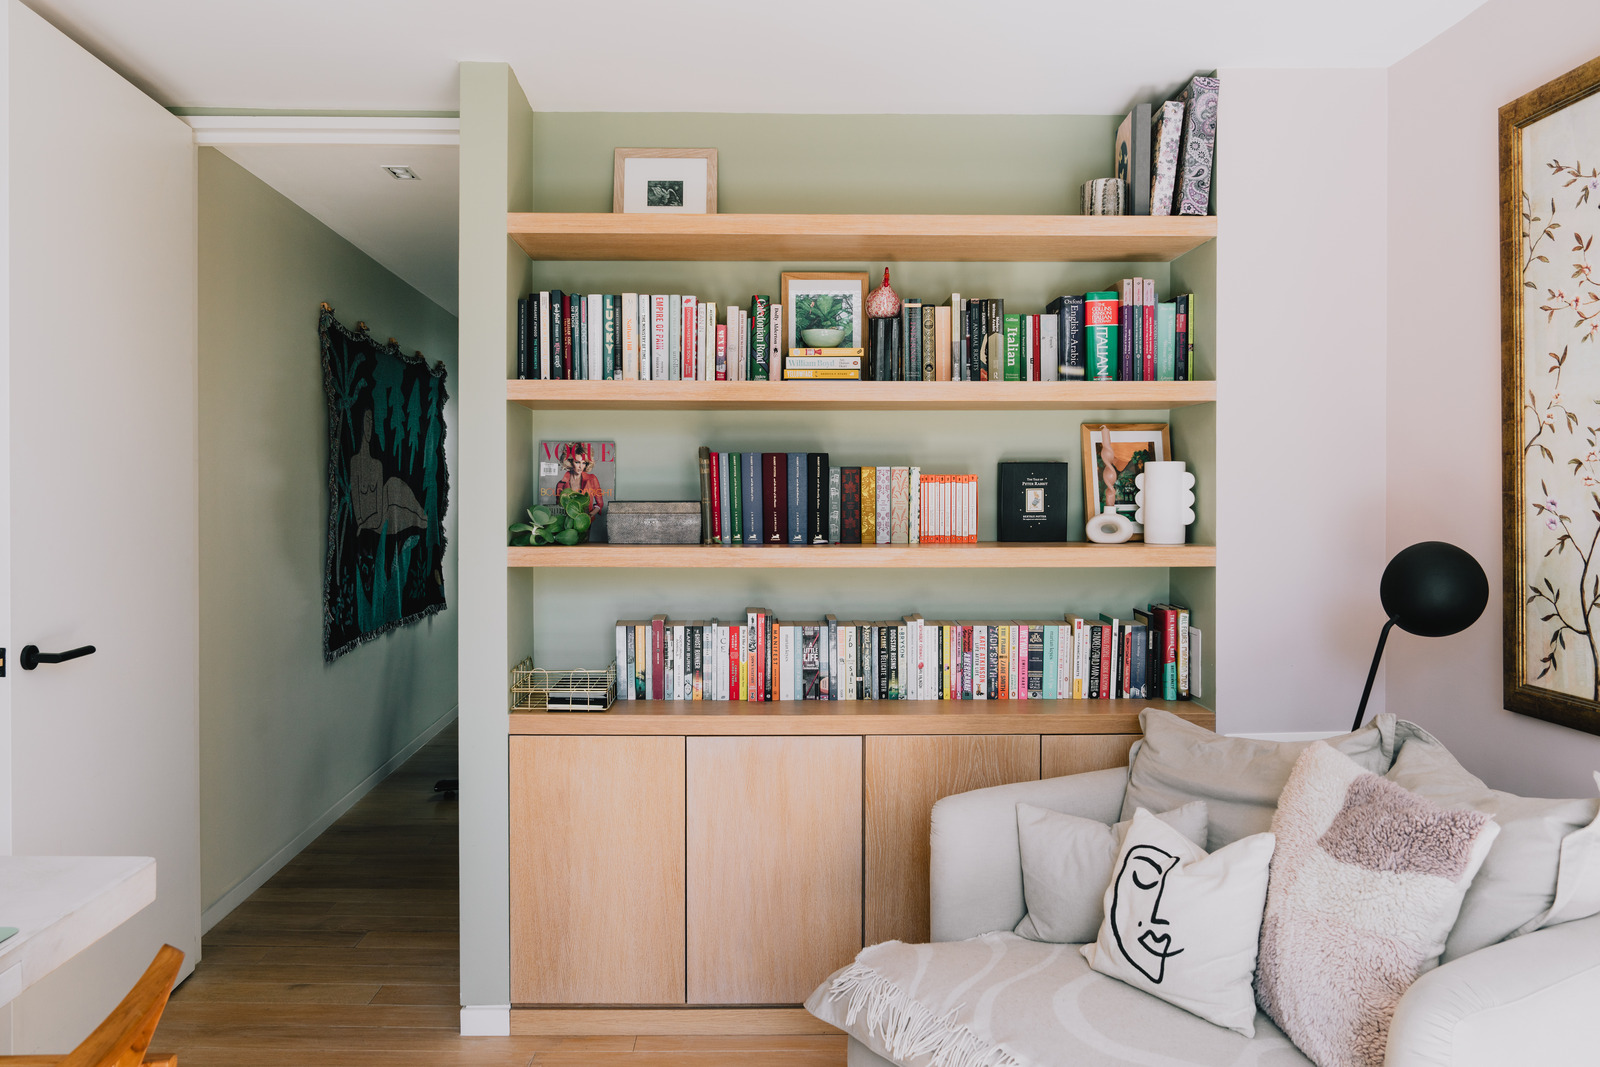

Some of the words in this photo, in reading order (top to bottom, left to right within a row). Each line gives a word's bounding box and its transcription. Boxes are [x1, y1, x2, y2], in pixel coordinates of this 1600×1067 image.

[656, 297, 664, 322] EMPIRE
[756, 299, 766, 342] Caledonian
[605, 299, 614, 354] LUCKY
[656, 324, 664, 332] OF
[1068, 305, 1078, 365] English-Arabic
[656, 334, 664, 350] PAIN
[718, 346, 724, 356] ED
[1007, 328, 1019, 366] Italian
[1096, 327, 1108, 375] ITALIAN
[756, 344, 766, 364] Road
[817, 360, 835, 368] Boyd
[542, 443, 614, 462] VOGUE
